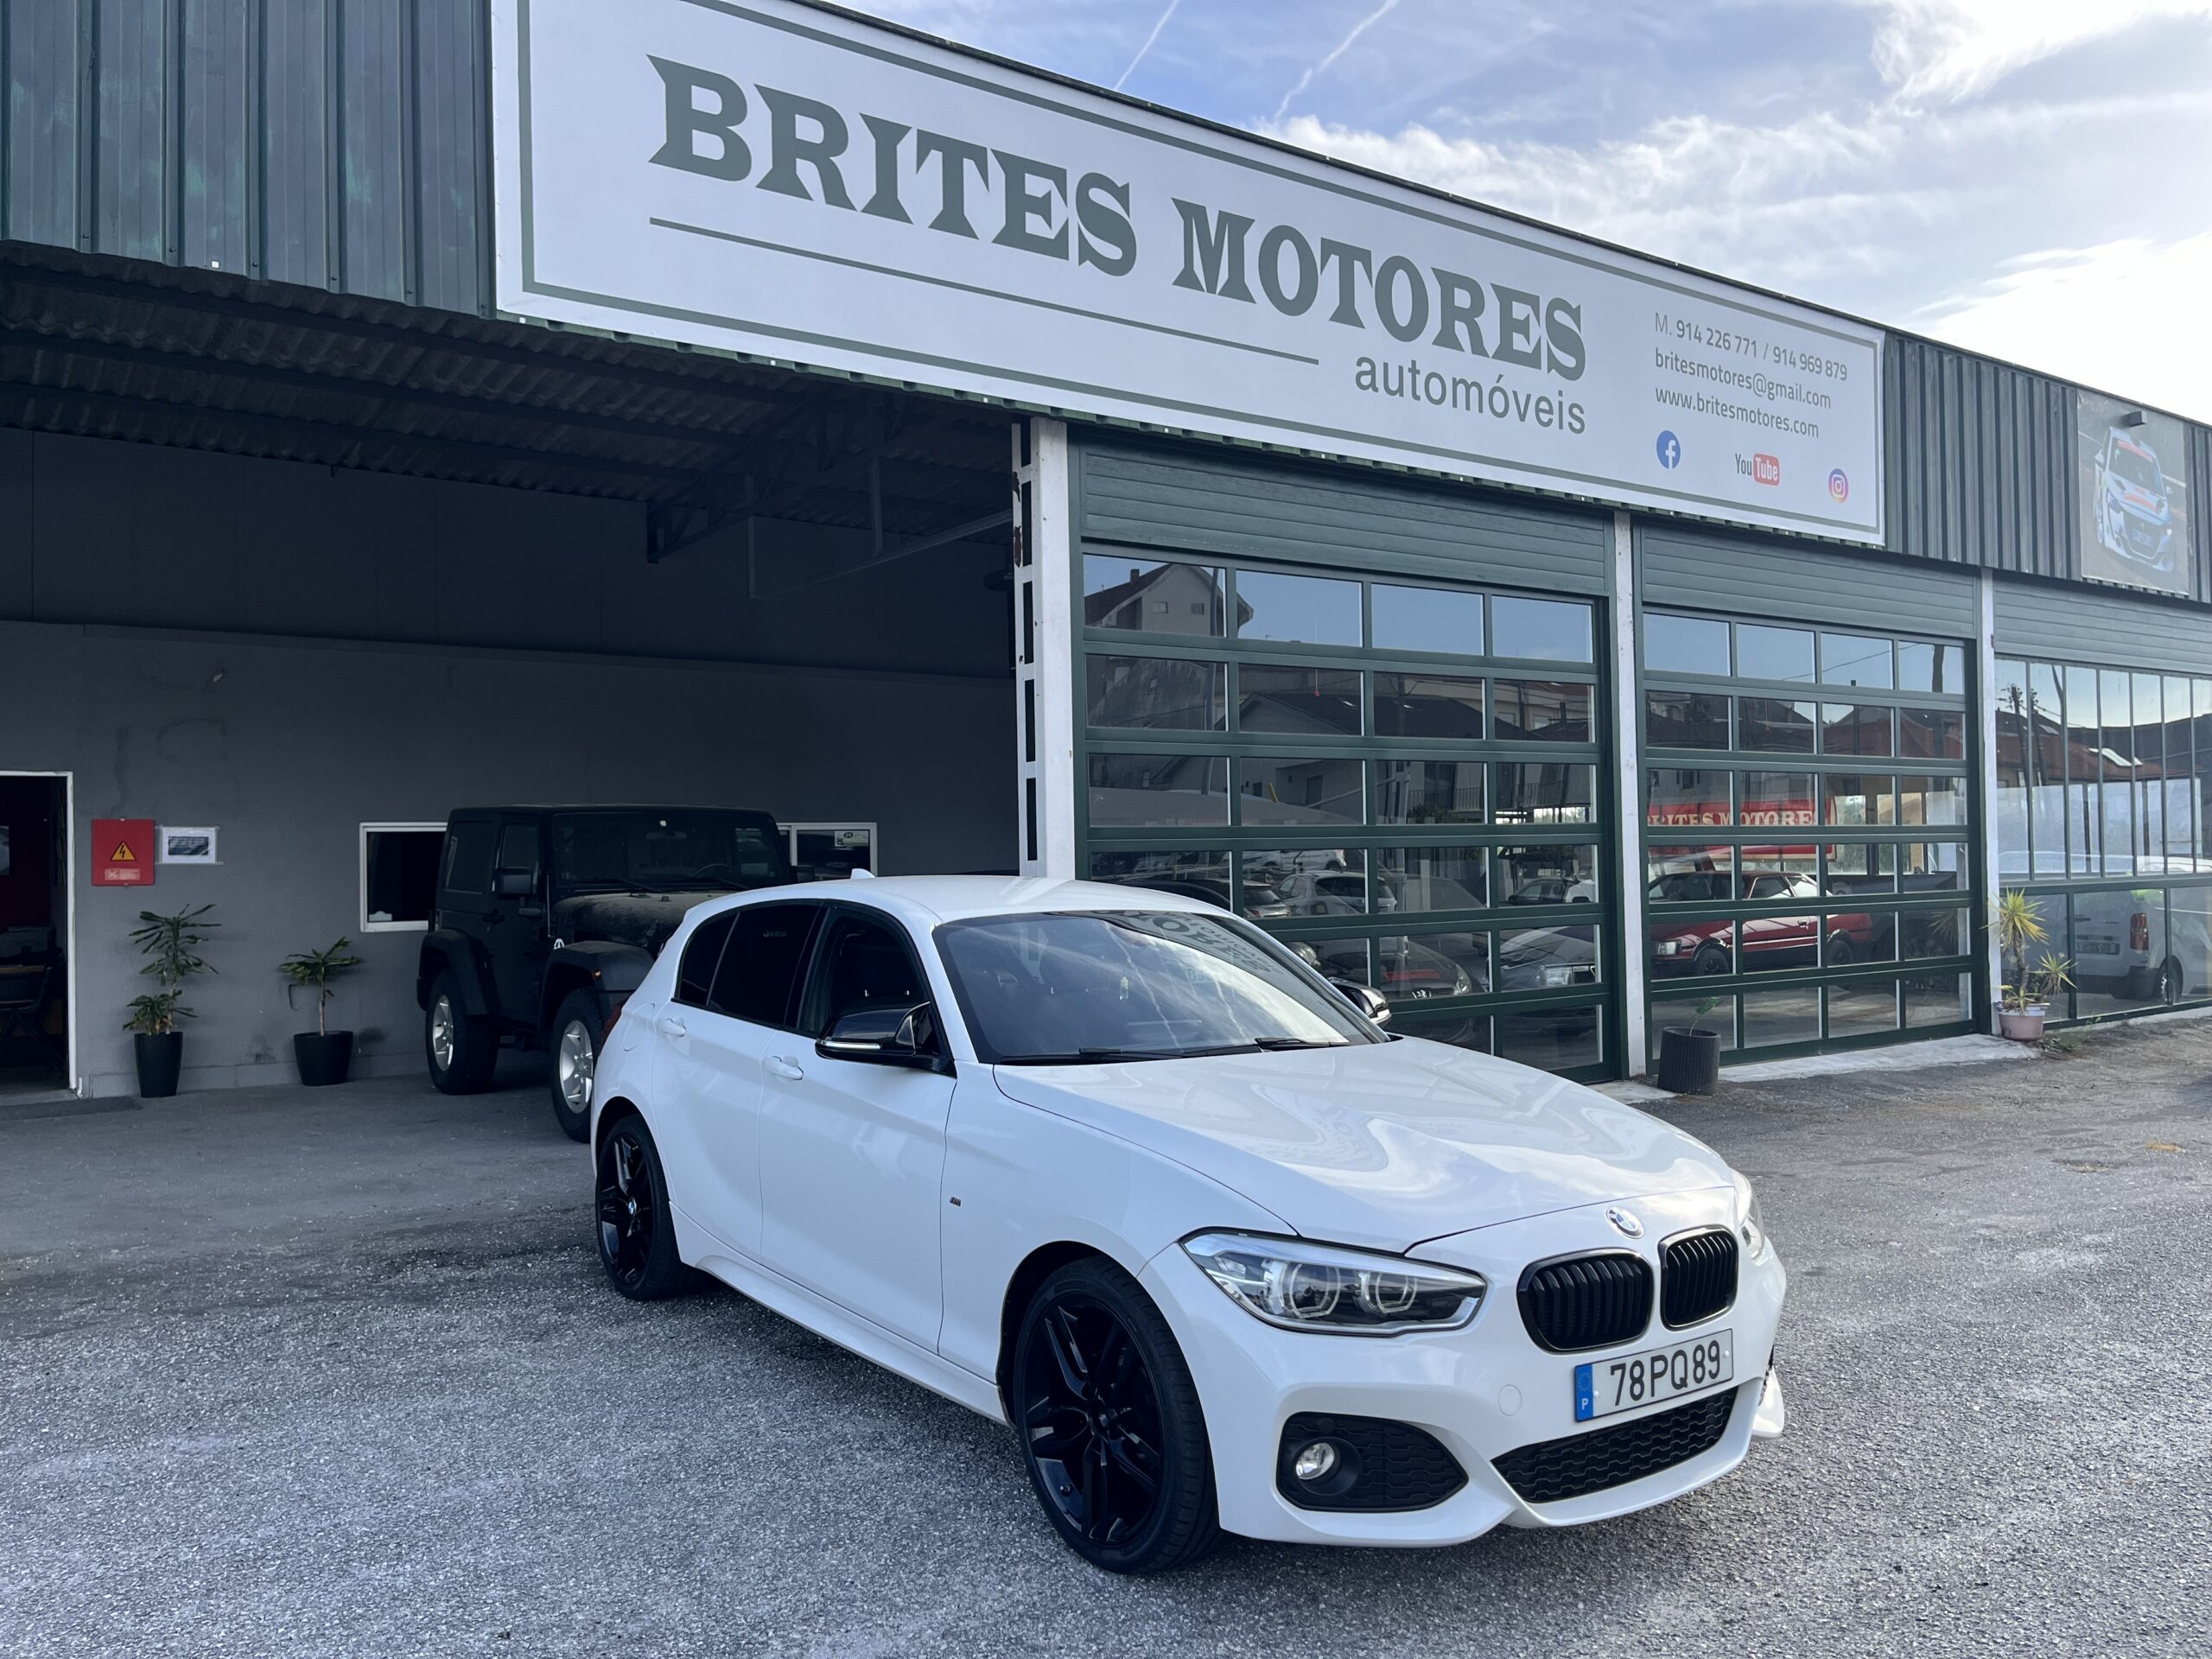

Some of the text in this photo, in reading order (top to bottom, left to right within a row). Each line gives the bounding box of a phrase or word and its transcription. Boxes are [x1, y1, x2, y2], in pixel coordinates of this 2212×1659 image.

[645, 54, 1586, 381] BRITES MOTORES
[1656, 313, 1672, 336] M.
[1676, 321, 1702, 344] 914
[1707, 329, 1731, 350] 226
[1735, 336, 1757, 358] 771
[1773, 346, 1796, 368] 914
[1800, 353, 1822, 374] 969
[1825, 359, 1847, 381] 879
[1656, 347, 1831, 409] britesmotores@gmail.com
[1356, 356, 1586, 435] automóveis
[1656, 388, 1819, 438] www.britesmotores.com
[1582, 1398, 1588, 1409] P
